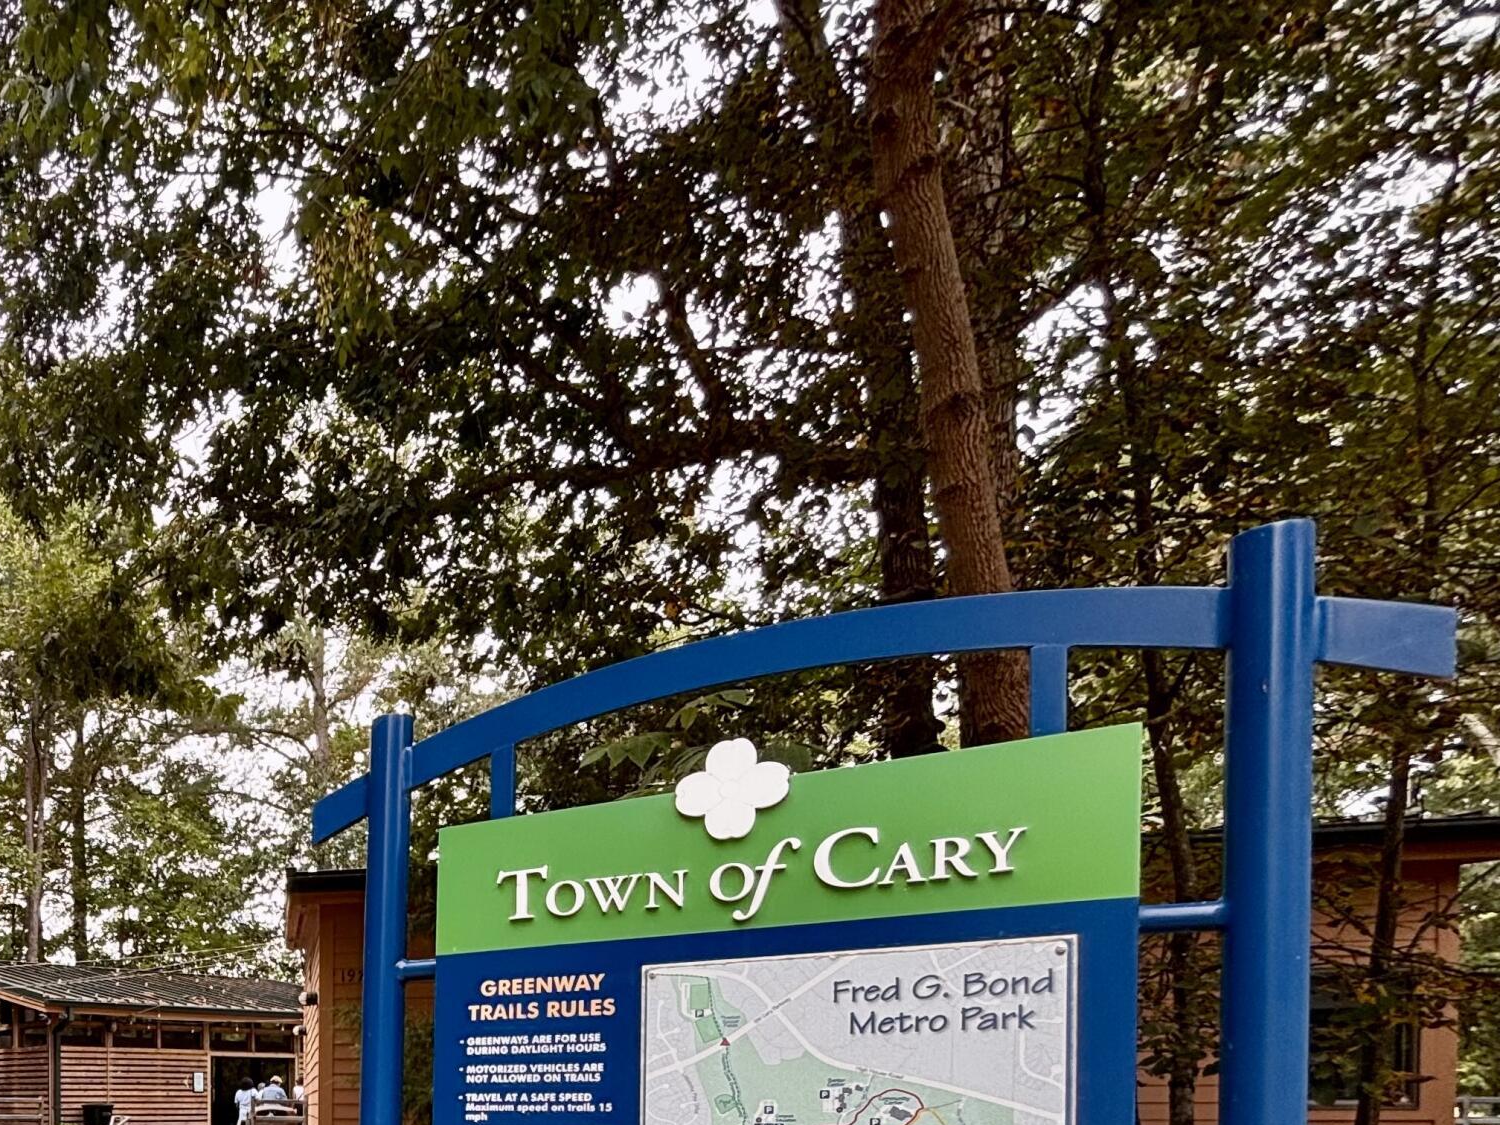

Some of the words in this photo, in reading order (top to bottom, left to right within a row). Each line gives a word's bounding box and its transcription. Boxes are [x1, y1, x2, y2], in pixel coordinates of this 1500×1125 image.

[710, 838, 802, 922] of
[480, 973, 605, 997] GREENWAY
[833, 977, 900, 1003] Fred
[912, 975, 950, 999] G.
[963, 968, 1053, 997] Bond
[468, 1003, 539, 1021] TRAILS
[547, 999, 616, 1018] RULES
[850, 1011, 948, 1034] Metro
[961, 1004, 1035, 1031] Park
[467, 1036, 528, 1046] GREENWAYS
[532, 1035, 551, 1044] ARE
[555, 1034, 576, 1043] FOR
[580, 1034, 601, 1042] USE
[467, 1046, 508, 1055] DURING
[511, 1044, 563, 1054] DAYLIGHT
[567, 1043, 606, 1053] HOURS
[467, 1065, 527, 1073] MOTORIZED
[530, 1064, 579, 1073] VEHICLES
[583, 1063, 604, 1072] ARE
[466, 1075, 488, 1084] NOT
[491, 1074, 540, 1083] ALLOWED
[544, 1074, 561, 1082] ON
[564, 1073, 601, 1082] TRAILS
[466, 1093, 502, 1102] TRAVEL
[505, 1093, 518, 1101] AT
[520, 1093, 528, 1101] A
[531, 1093, 556, 1101] SAFE
[559, 1093, 592, 1101] SPEED
[517, 1103, 548, 1113] speed
[465, 1113, 487, 1122] mph
